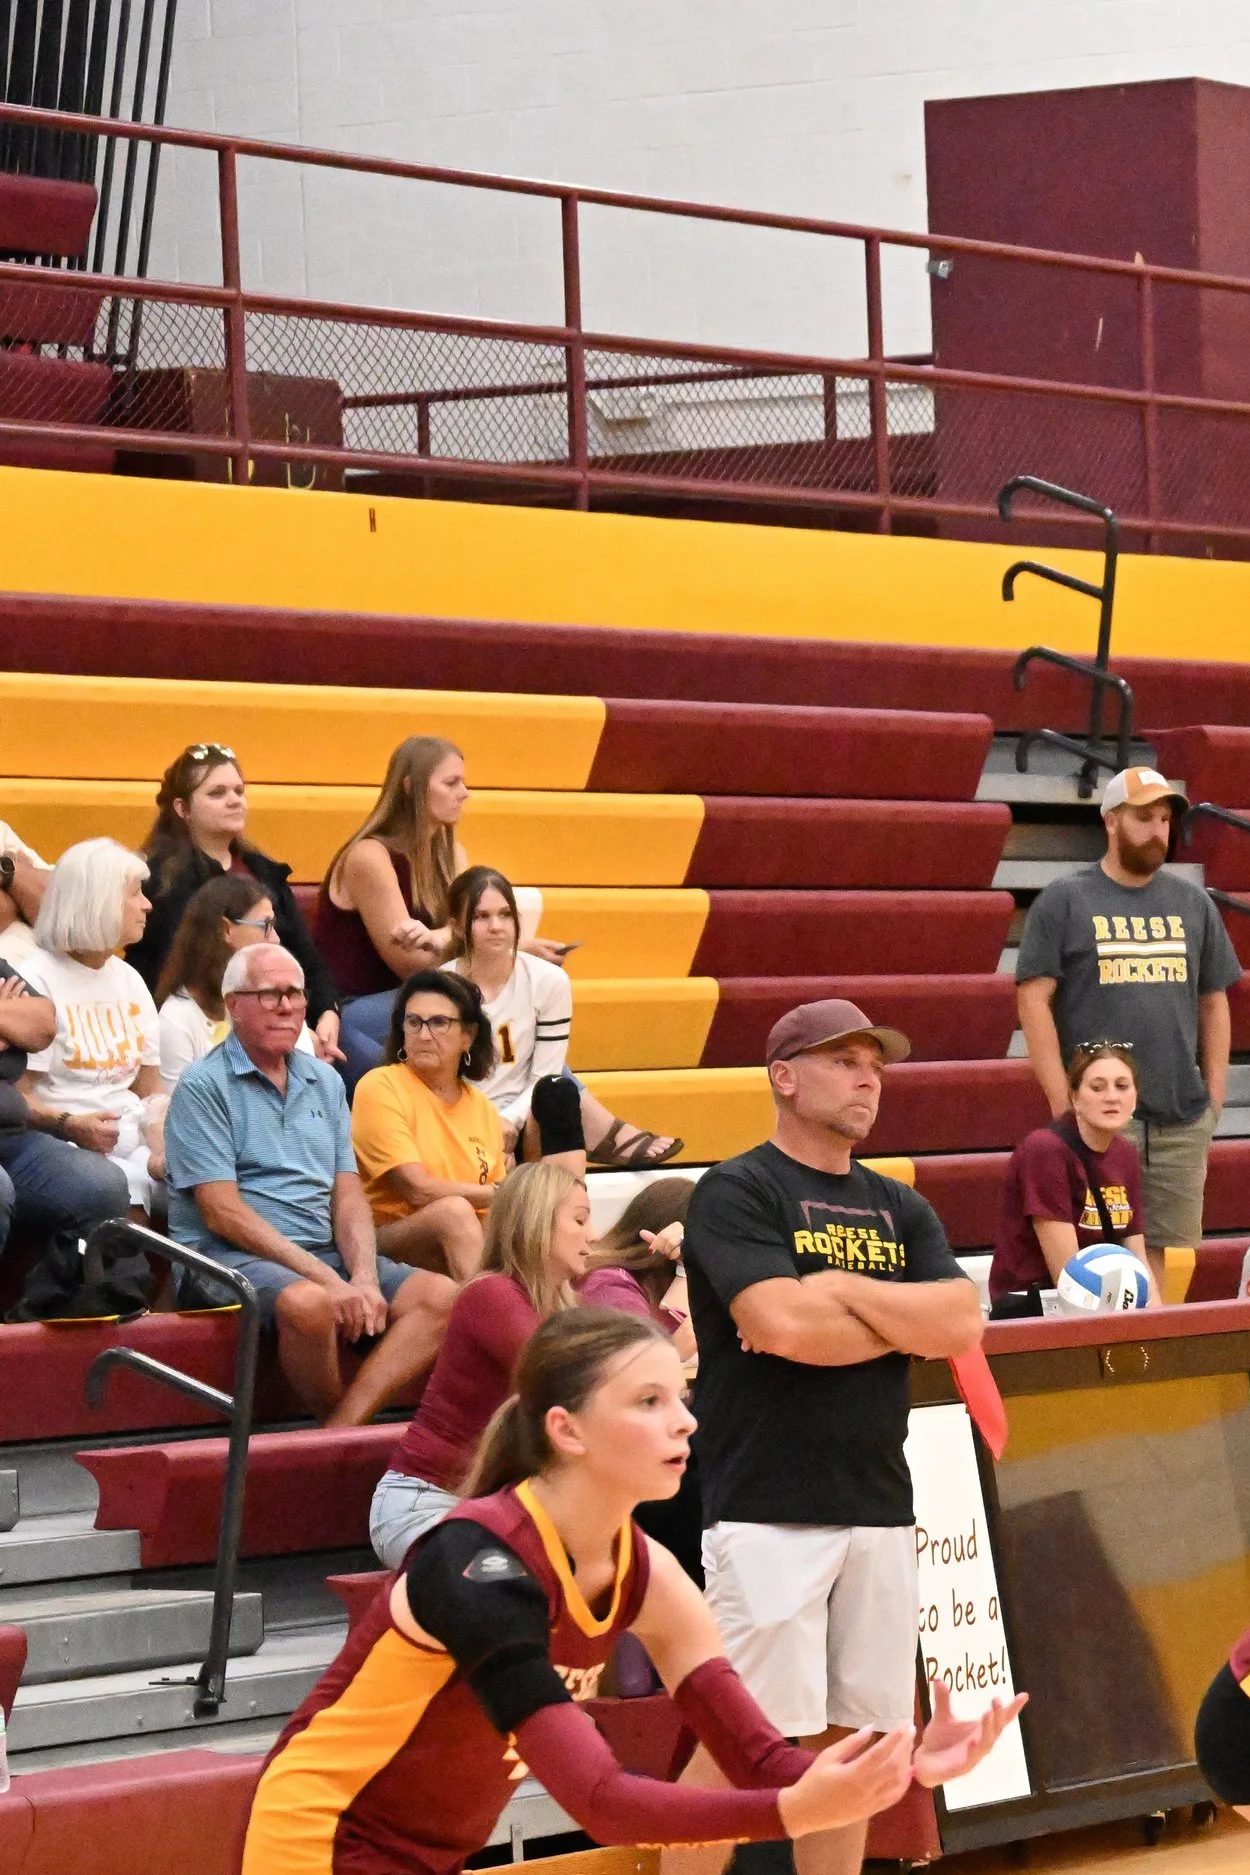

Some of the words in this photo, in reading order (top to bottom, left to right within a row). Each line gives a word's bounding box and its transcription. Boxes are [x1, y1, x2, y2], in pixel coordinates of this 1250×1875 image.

[1092, 915, 1185, 940] REESE
[1097, 957, 1188, 984] ROCKETS
[825, 1223, 880, 1241] REESE
[914, 1518, 978, 1568] Proud
[952, 1587, 977, 1628] be
[988, 1595, 999, 1621] a
[926, 1645, 1007, 1693] Rocket!
